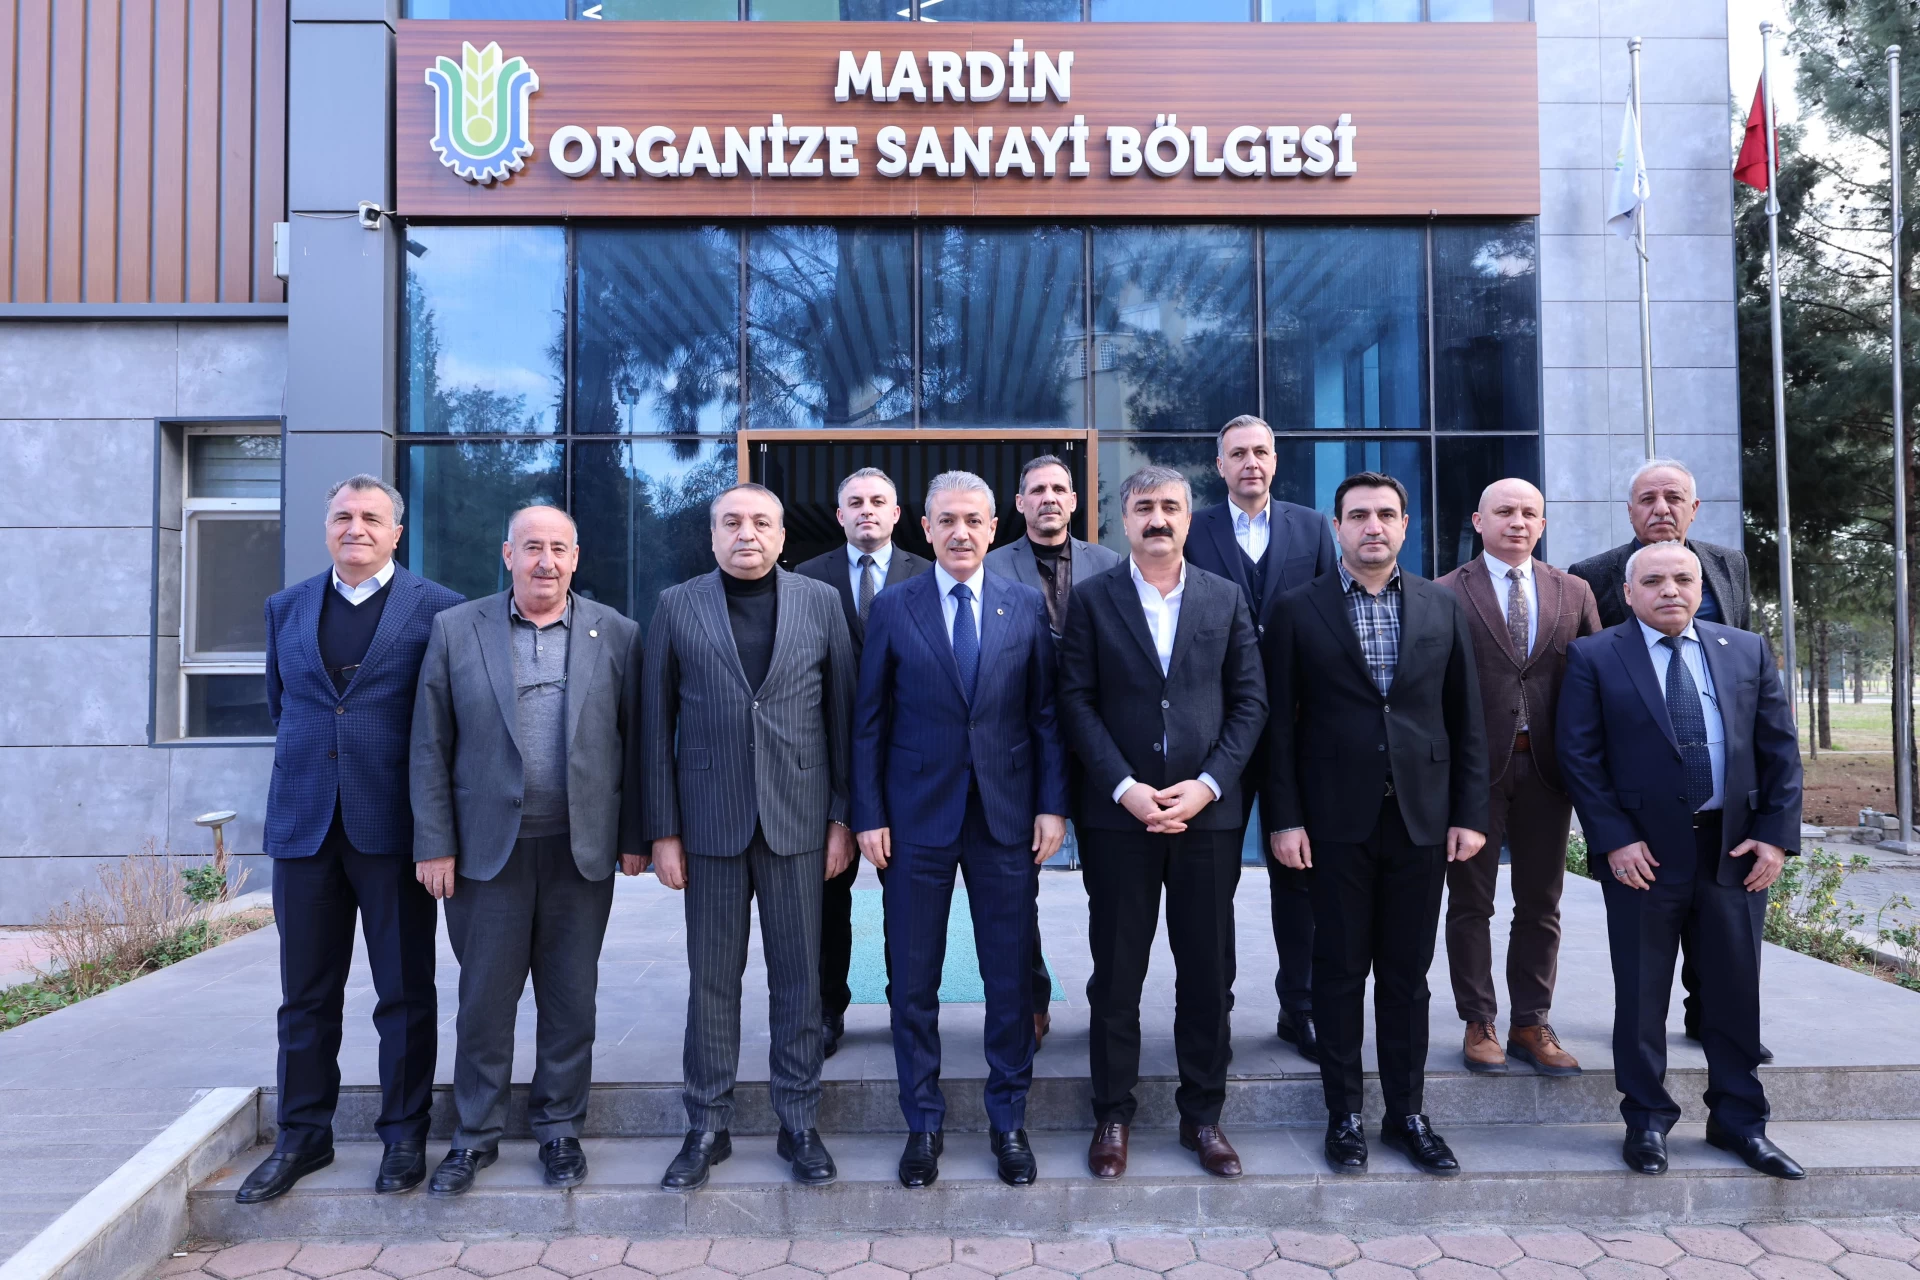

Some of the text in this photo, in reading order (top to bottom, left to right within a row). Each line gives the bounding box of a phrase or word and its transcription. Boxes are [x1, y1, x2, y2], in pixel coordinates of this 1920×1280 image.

[834, 38, 1074, 102] MARDİN
[549, 113, 1358, 177] ORGANİZE SANAYİ BÖLGESİ
